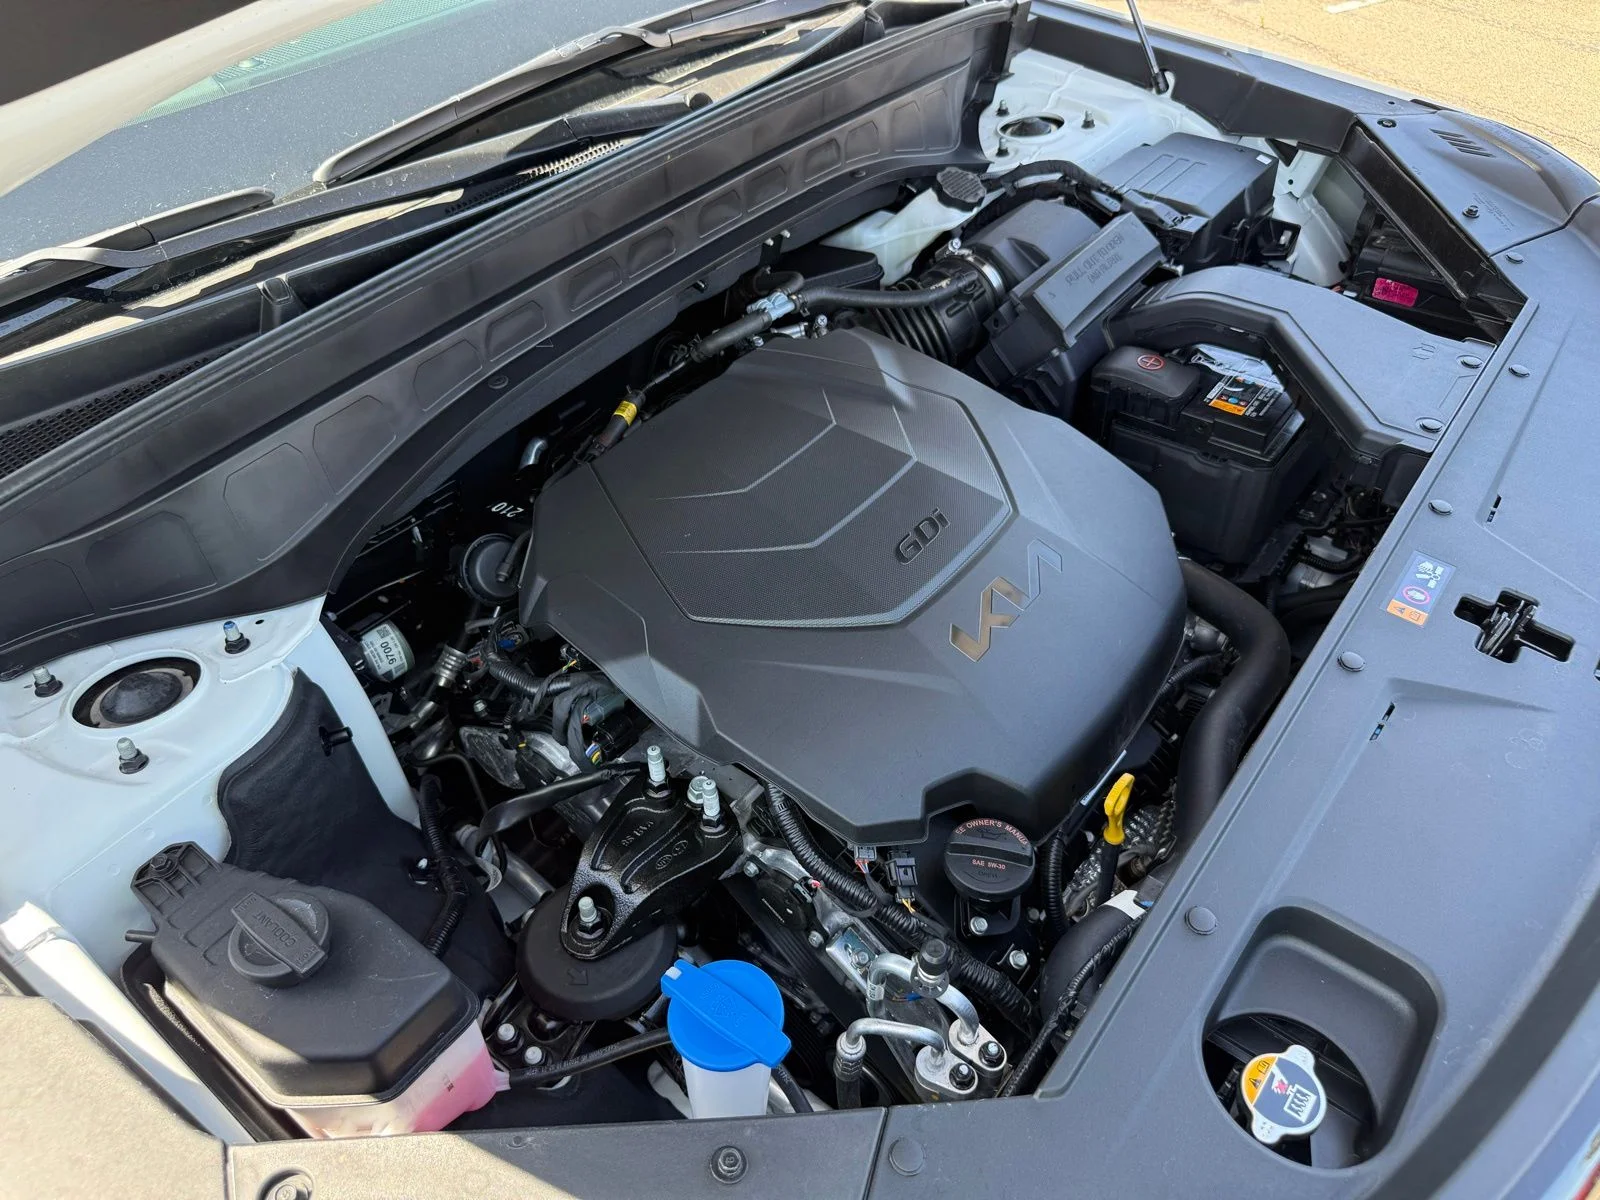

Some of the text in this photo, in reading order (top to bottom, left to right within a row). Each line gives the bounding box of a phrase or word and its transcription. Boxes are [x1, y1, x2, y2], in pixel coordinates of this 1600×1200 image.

[894, 506, 951, 566] GDi
[948, 538, 1063, 663] KIA
[380, 641, 397, 665] 9700
[966, 819, 1002, 828] OWNER'S
[972, 859, 985, 867] SAE
[252, 911, 296, 947] COOLANT
